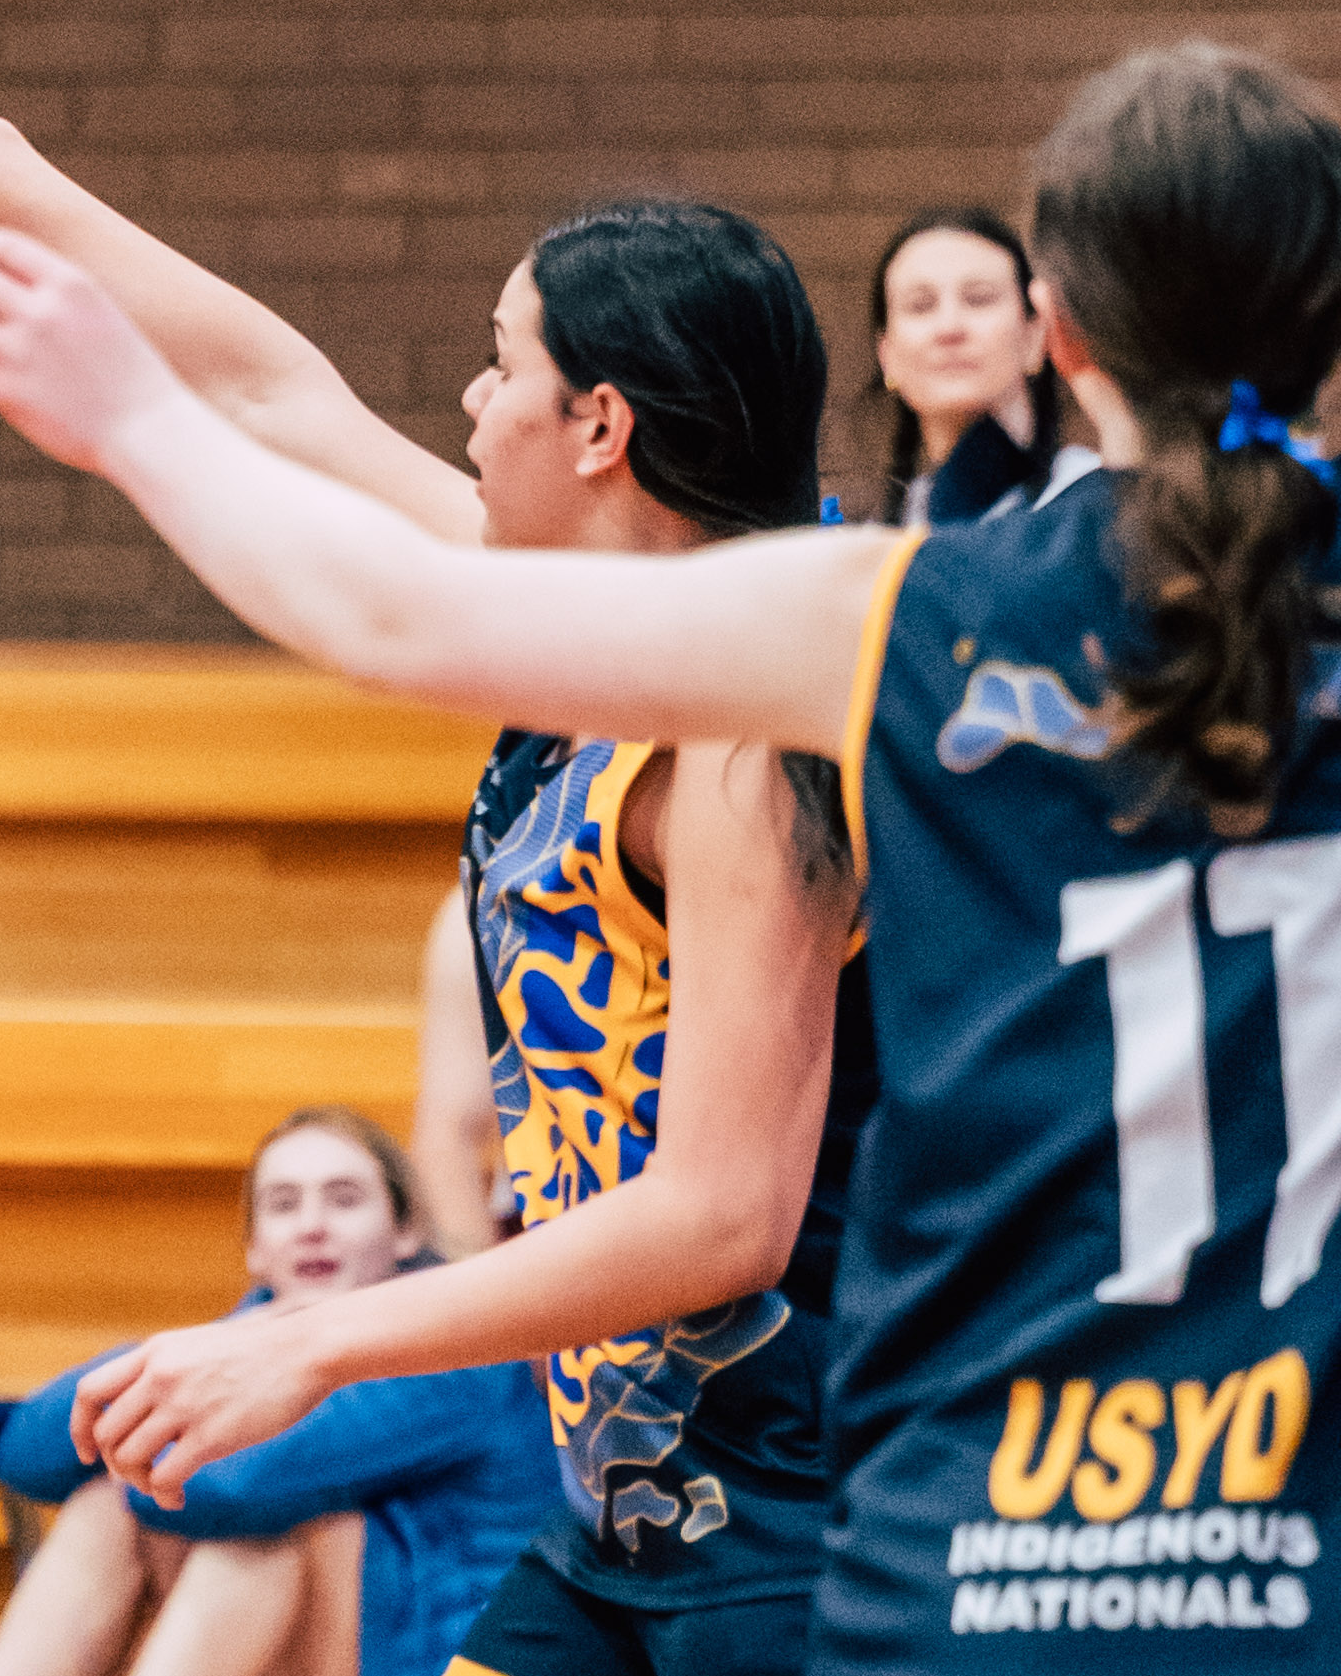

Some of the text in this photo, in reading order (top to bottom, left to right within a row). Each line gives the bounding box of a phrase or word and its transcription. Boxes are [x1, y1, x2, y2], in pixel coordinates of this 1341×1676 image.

[987, 1347, 1312, 1524] USYD
[947, 1506, 1321, 1578] INDIGENOUS
[950, 1573, 1312, 1635] NATIONALS
